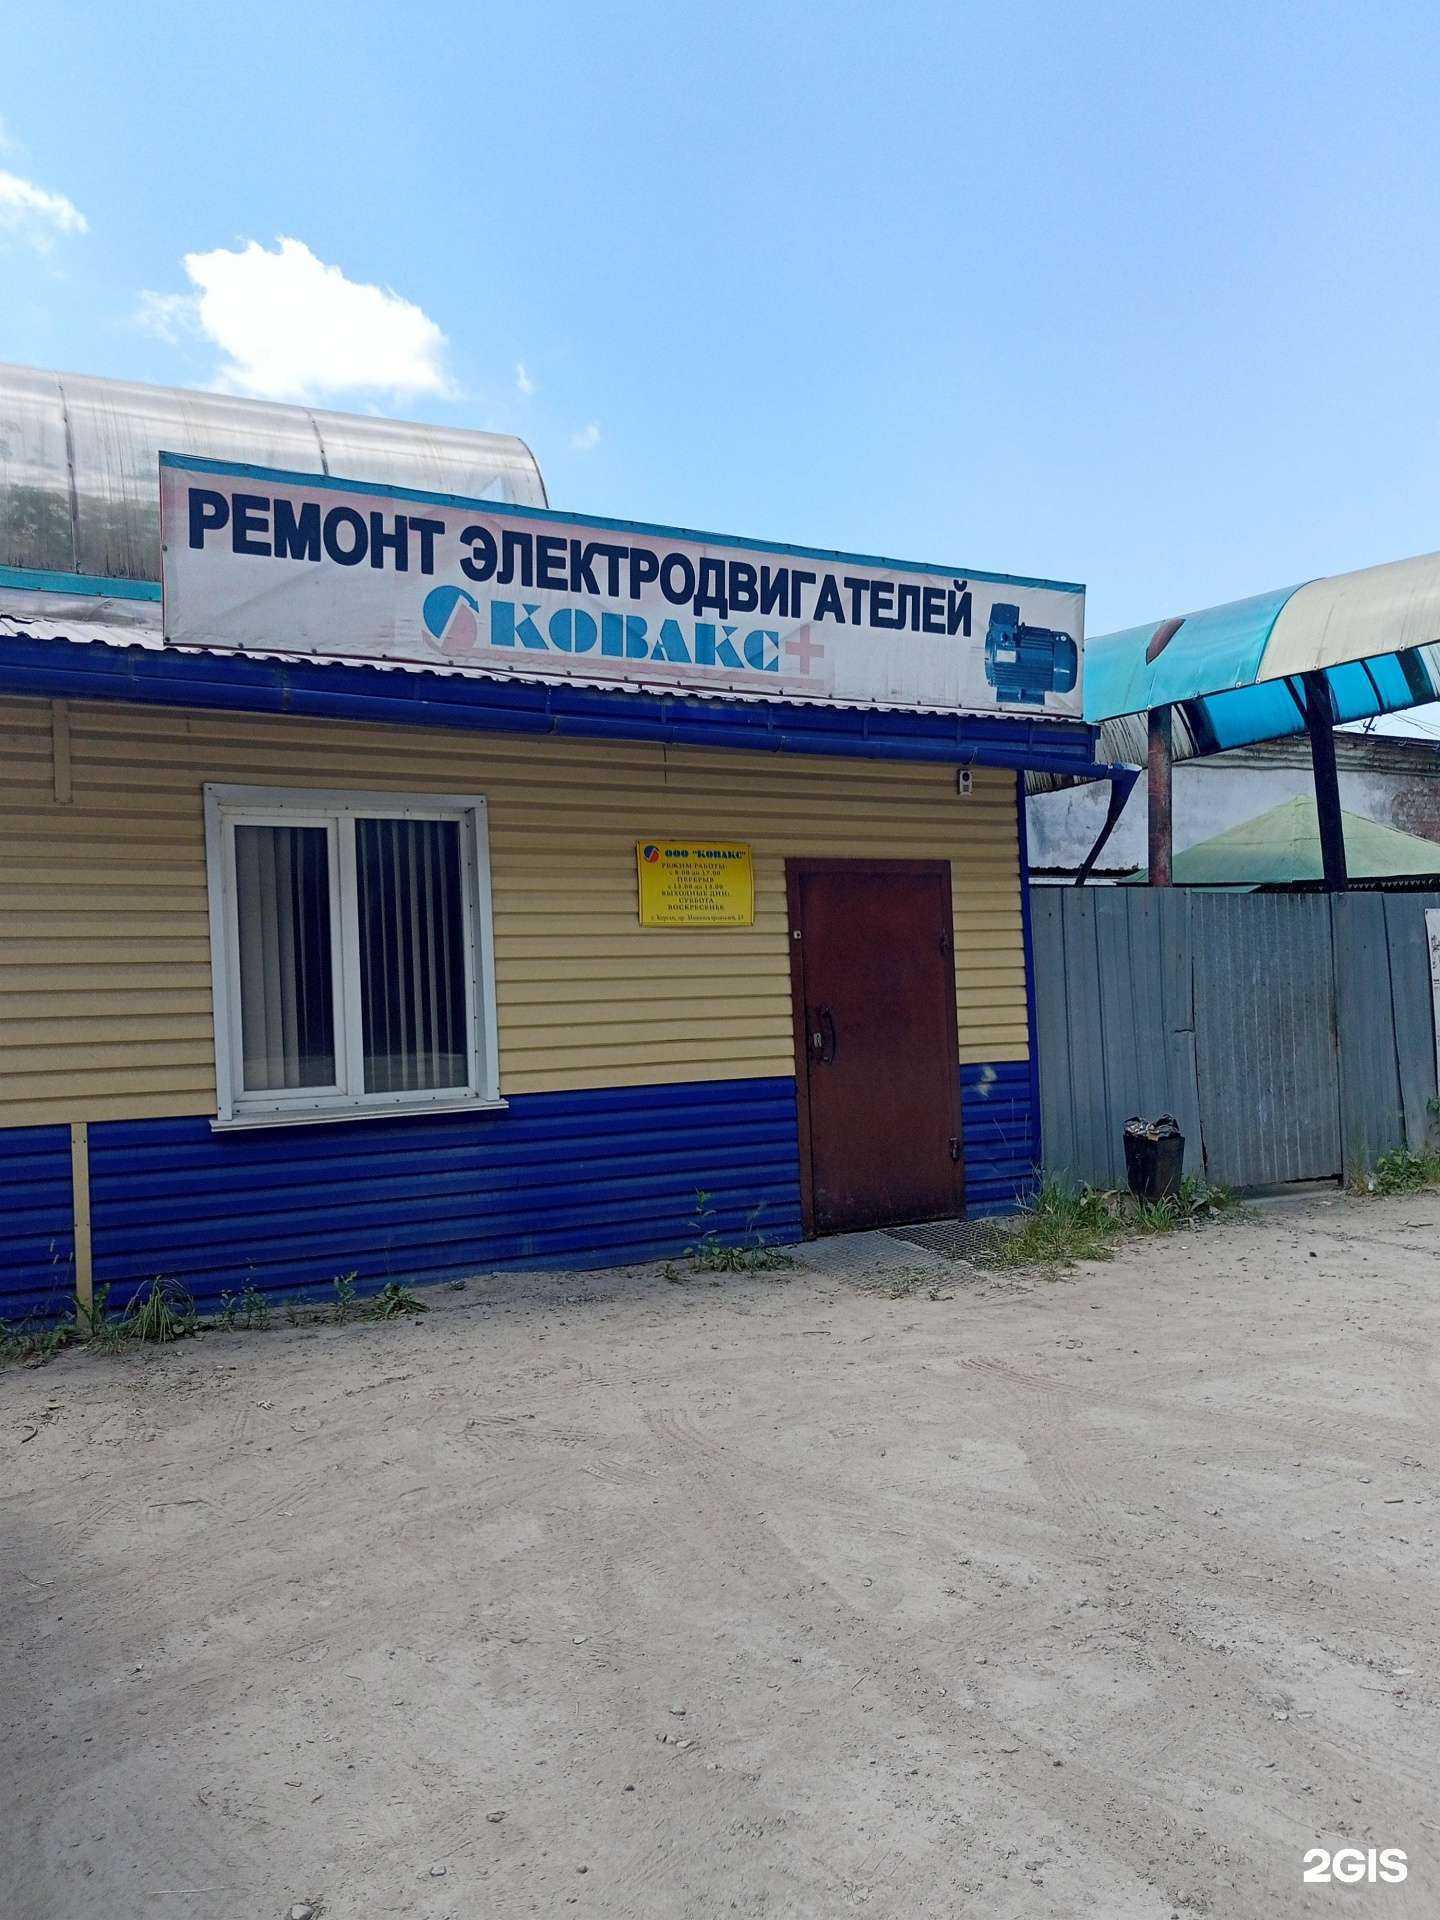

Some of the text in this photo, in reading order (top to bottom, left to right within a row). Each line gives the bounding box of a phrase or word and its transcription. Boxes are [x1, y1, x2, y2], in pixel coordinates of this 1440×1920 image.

[188, 487, 972, 637] РЕМОНТ ЭЛЕКТРОДВИГАТЕЛЕЙ
[665, 849, 689, 858] ООО
